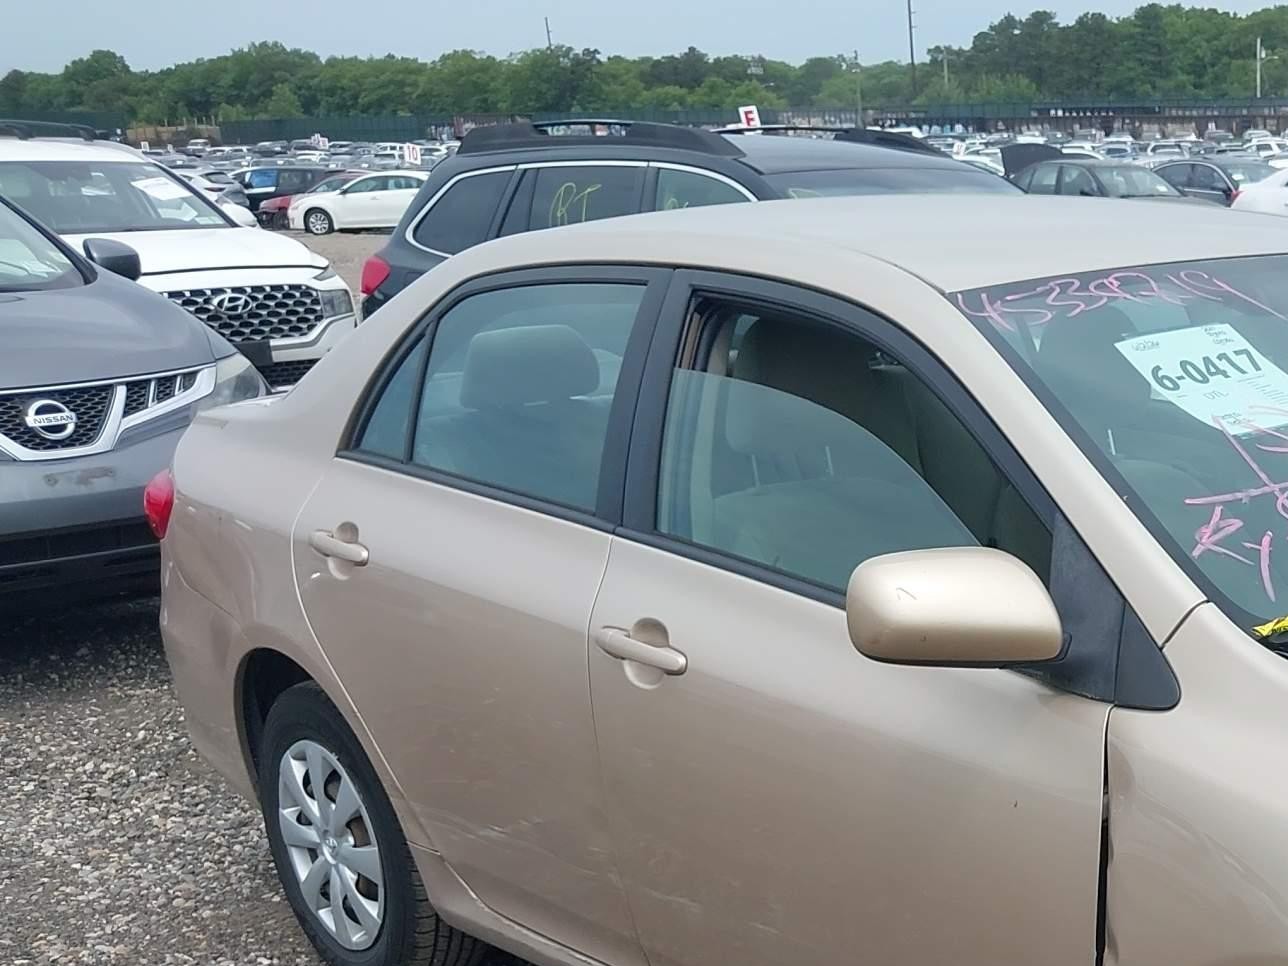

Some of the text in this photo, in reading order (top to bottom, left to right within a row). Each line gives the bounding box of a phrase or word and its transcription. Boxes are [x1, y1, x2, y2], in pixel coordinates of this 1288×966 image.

[744, 109, 756, 127] F
[1151, 348, 1263, 392] 6-0417
[33, 414, 74, 424] NISSAN
